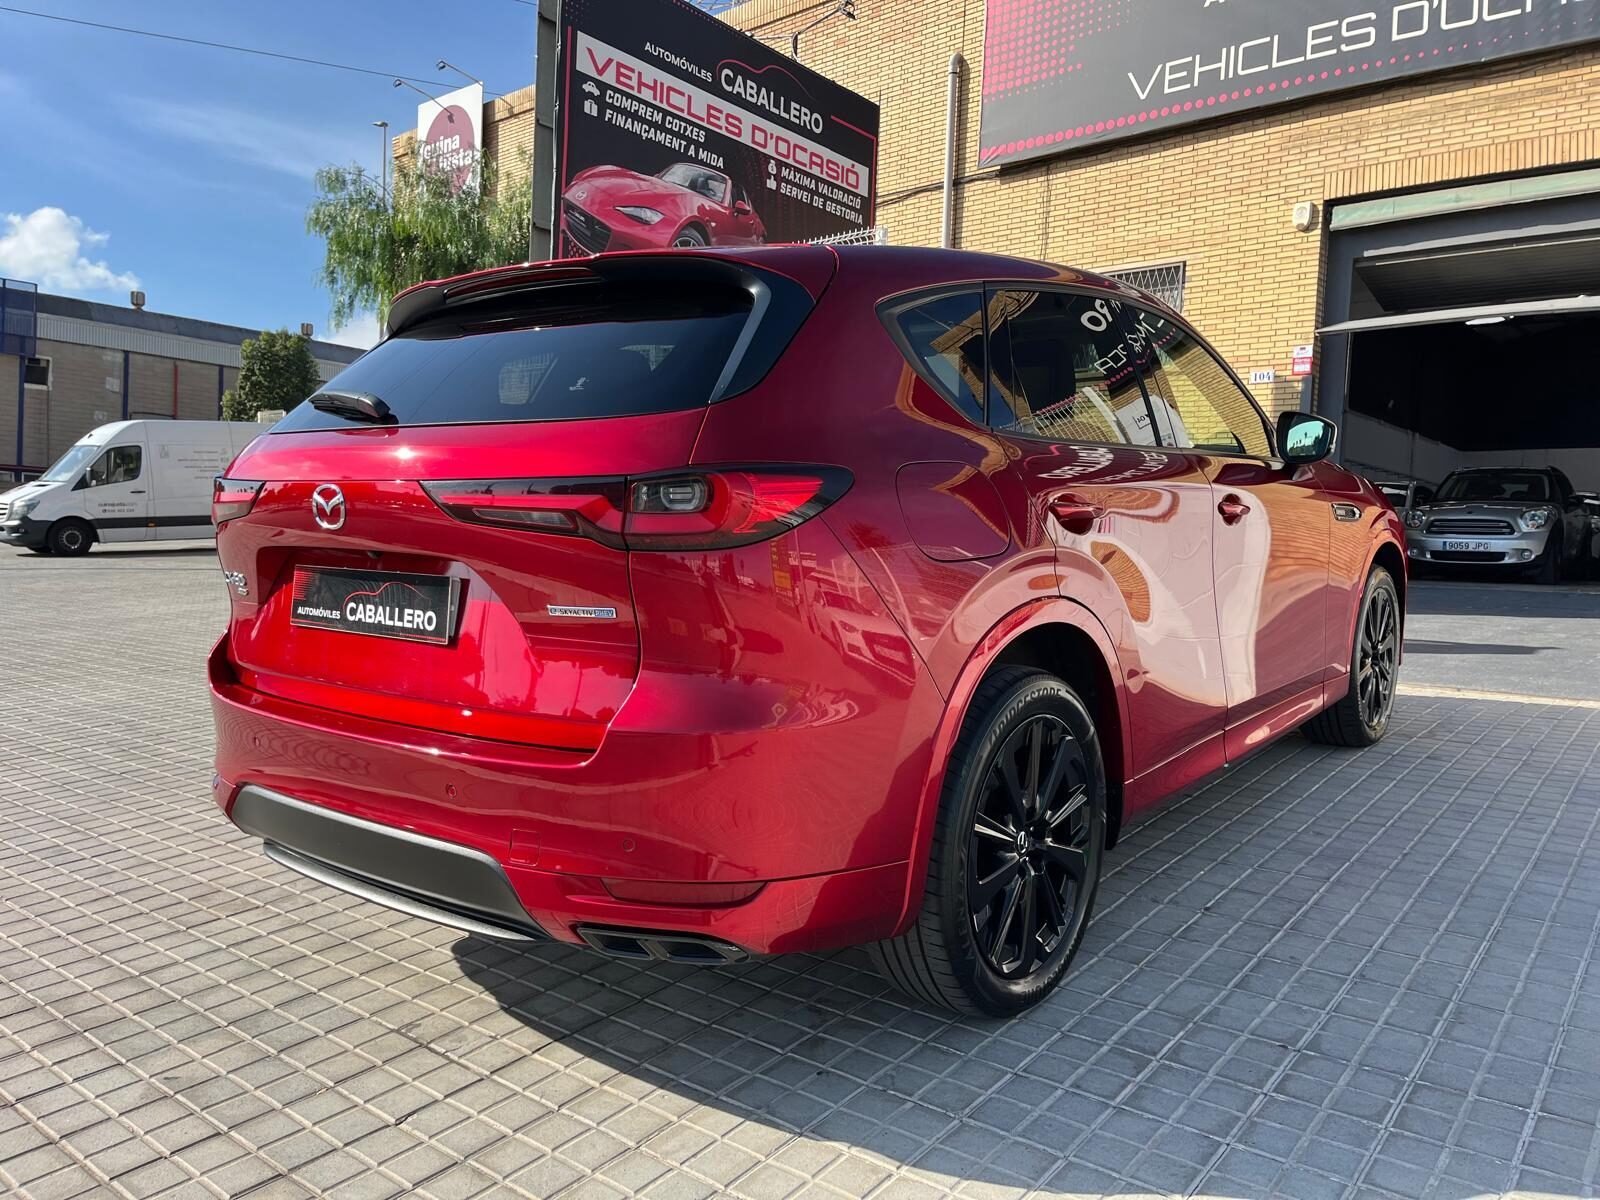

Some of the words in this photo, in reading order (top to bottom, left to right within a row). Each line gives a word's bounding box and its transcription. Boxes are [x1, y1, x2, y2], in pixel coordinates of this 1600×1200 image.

[1127, 11, 1377, 100] VEHICLES
[644, 41, 713, 83] AUTOMÓVILES
[720, 68, 824, 134] CABALLERO
[586, 47, 743, 138] VEHICLES
[751, 123, 860, 190] D'OCASIÓ
[604, 109, 686, 155] FINANÇAMENT
[687, 144, 696, 157] A
[698, 147, 724, 169] MIDA
[605, 89, 662, 123] COMPREM
[665, 116, 706, 143] COTXES
[780, 166, 815, 190] MÀXIMA
[818, 181, 861, 209] VALORACIÓ
[780, 181, 811, 203] SERVEI
[813, 195, 824, 206] DE
[825, 199, 864, 225] GESTORIA
[1254, 371, 1271, 382] 104
[1448, 541, 1470, 550] 9059
[297, 606, 341, 620] AUTOMÓVILES
[346, 602, 437, 631] CABALLERO
